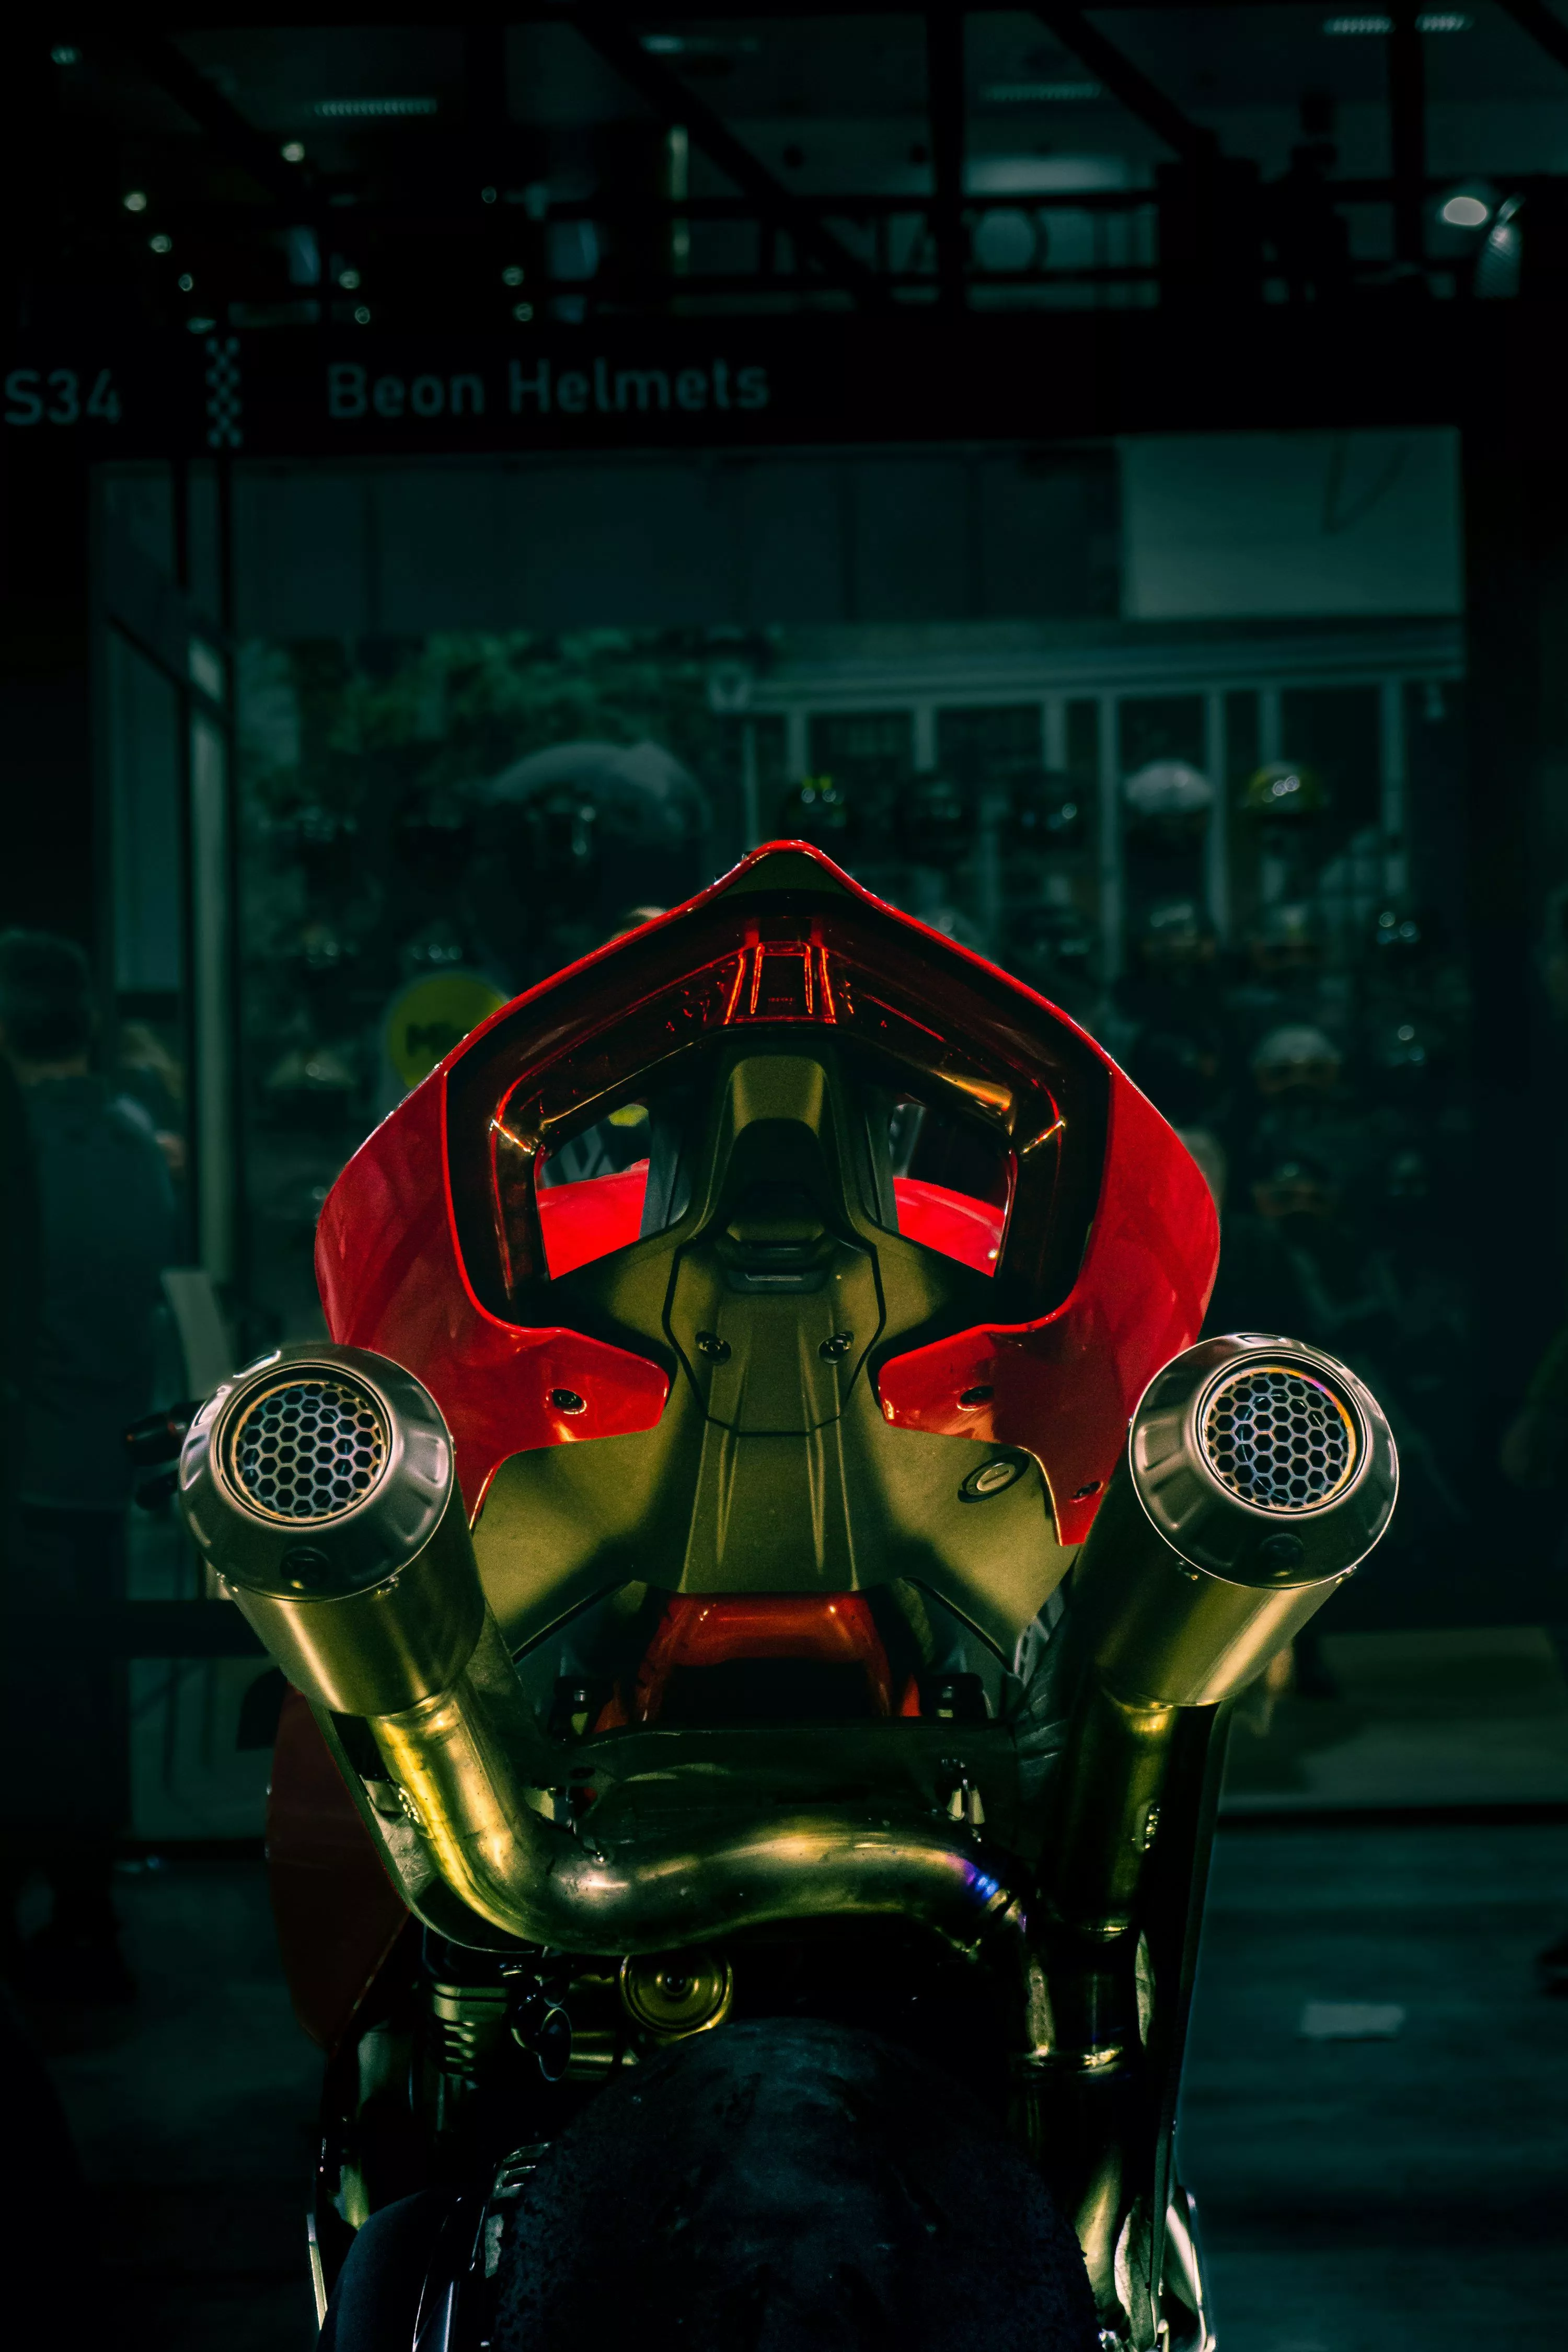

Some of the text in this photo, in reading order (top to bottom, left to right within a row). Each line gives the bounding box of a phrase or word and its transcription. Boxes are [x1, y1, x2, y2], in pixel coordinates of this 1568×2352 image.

[4, 368, 120, 426] S34
[328, 357, 770, 421] Beon Helmets
